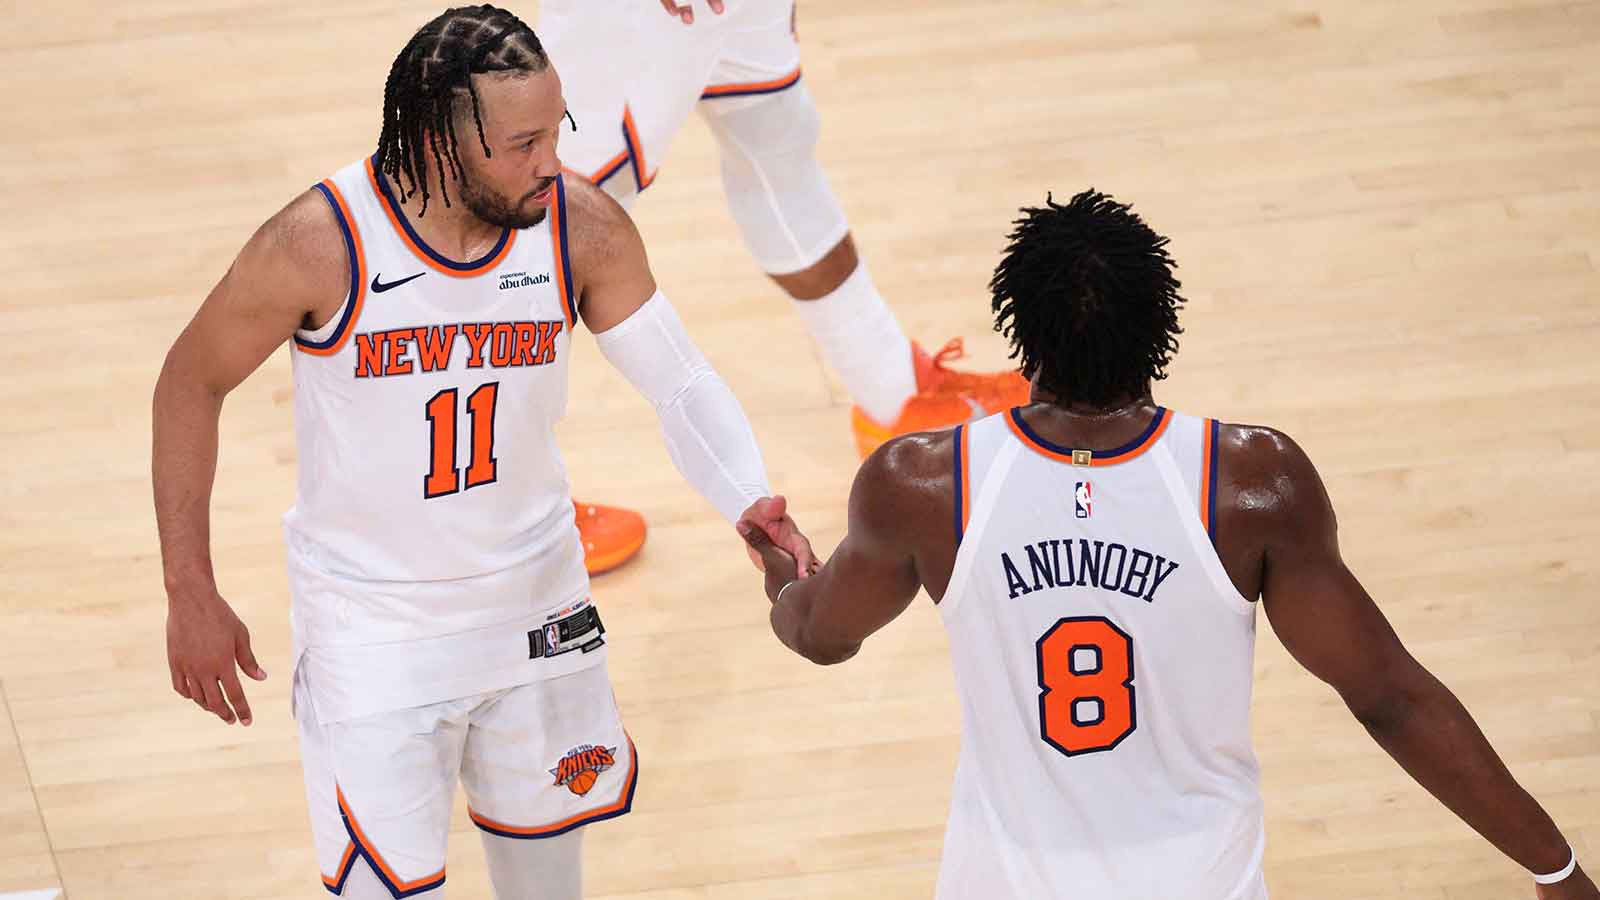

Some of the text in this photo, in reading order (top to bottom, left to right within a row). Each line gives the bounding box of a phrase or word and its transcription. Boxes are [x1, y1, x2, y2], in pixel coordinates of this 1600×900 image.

[499, 272, 550, 290] abu dhabi
[355, 321, 563, 378] NEW YORK
[424, 381, 500, 499] 11
[1001, 538, 1179, 603] ANUNOBY
[1035, 615, 1137, 757] 8
[553, 745, 615, 786] KNICKS
